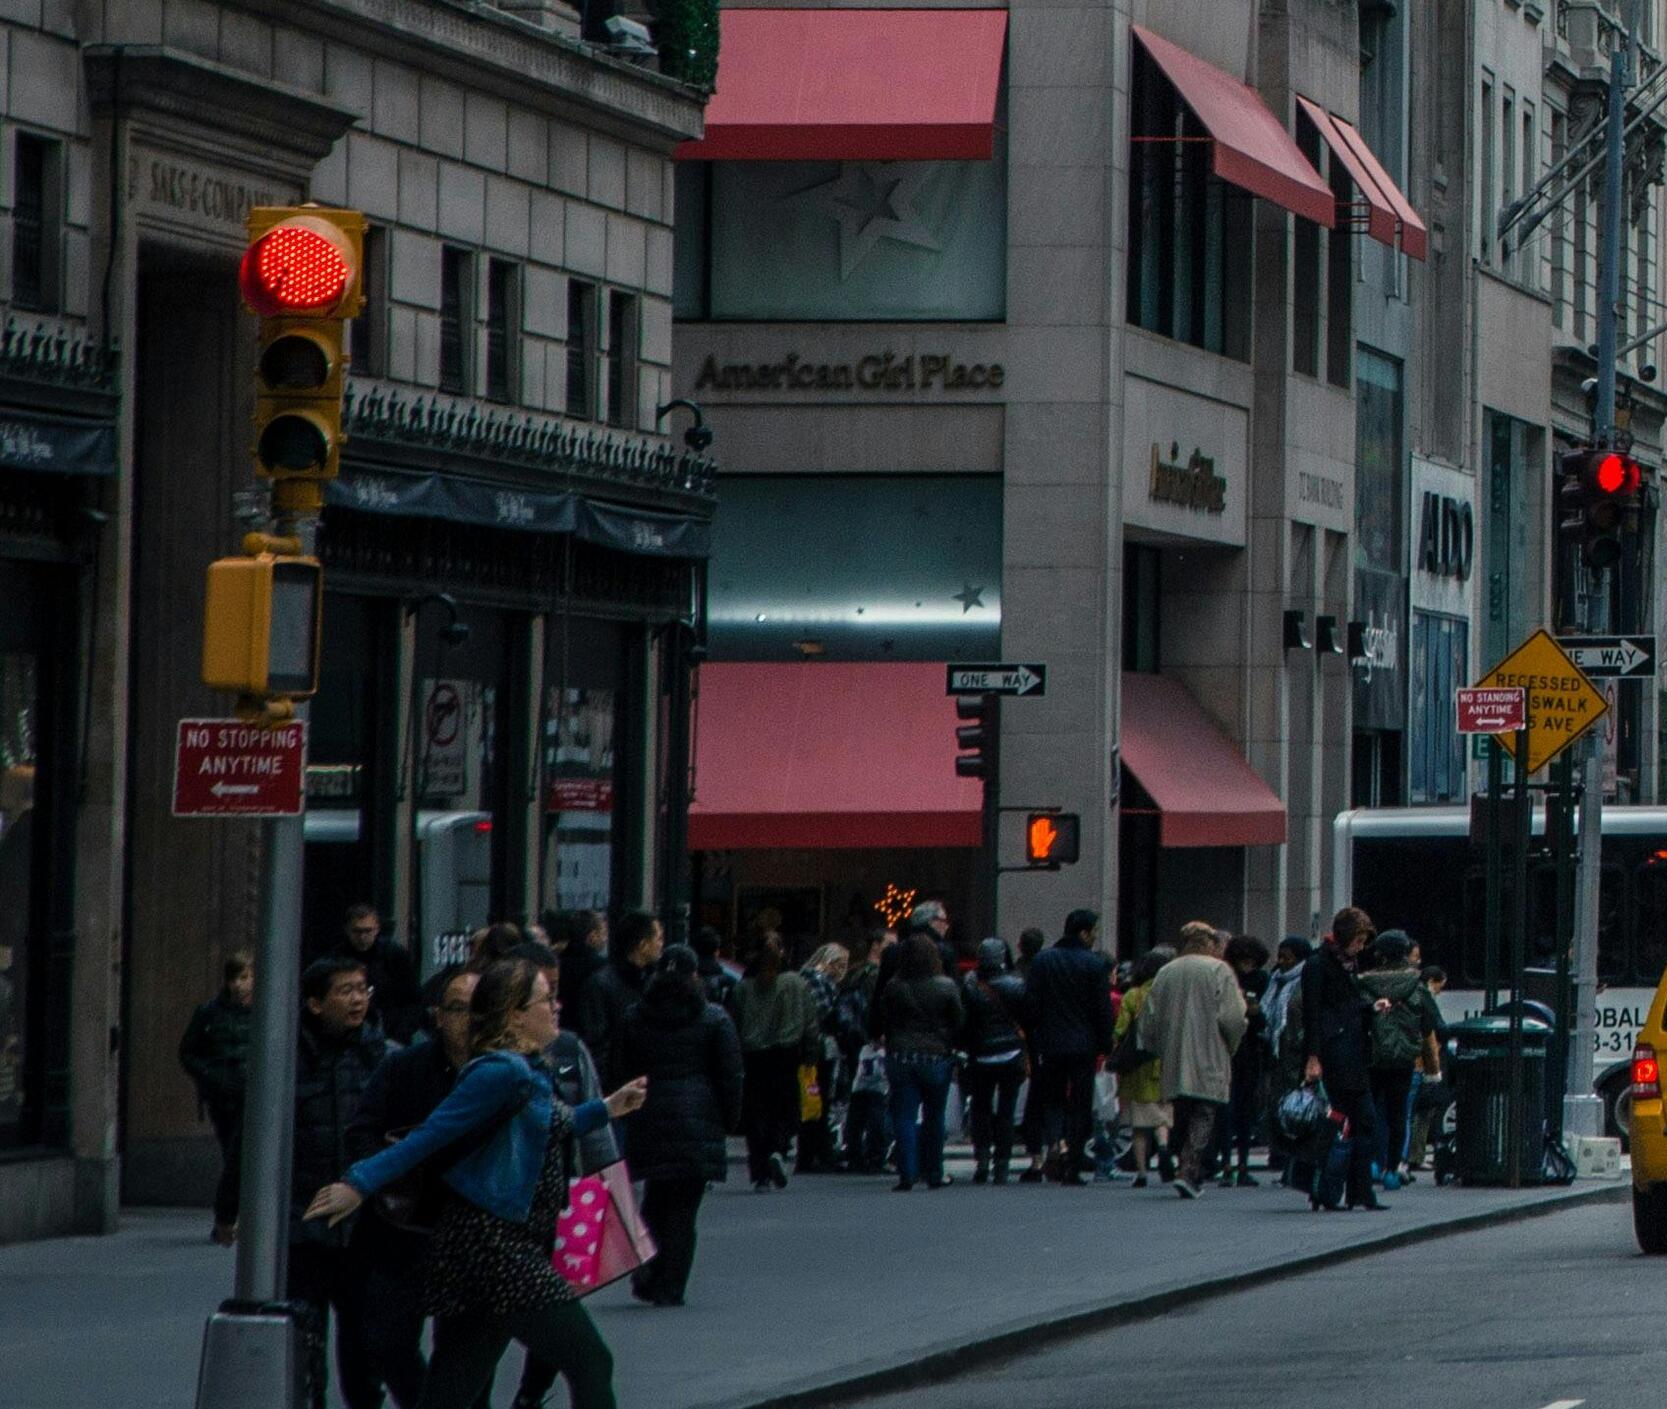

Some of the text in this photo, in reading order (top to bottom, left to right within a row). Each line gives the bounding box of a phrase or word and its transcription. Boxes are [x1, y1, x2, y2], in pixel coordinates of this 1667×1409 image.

[695, 351, 1005, 390] American Girl Place
[1601, 650, 1637, 665] WAY
[961, 674, 1030, 687] ONE WAY
[1496, 673, 1581, 692] RECESSED
[1460, 691, 1520, 704] NO STANDING
[1532, 695, 1589, 713] SWALK
[1468, 705, 1514, 715] ANYTIME
[1544, 718, 1575, 732] AVE
[187, 728, 297, 748] NO STOPPING
[199, 755, 283, 775] ANYTIME
